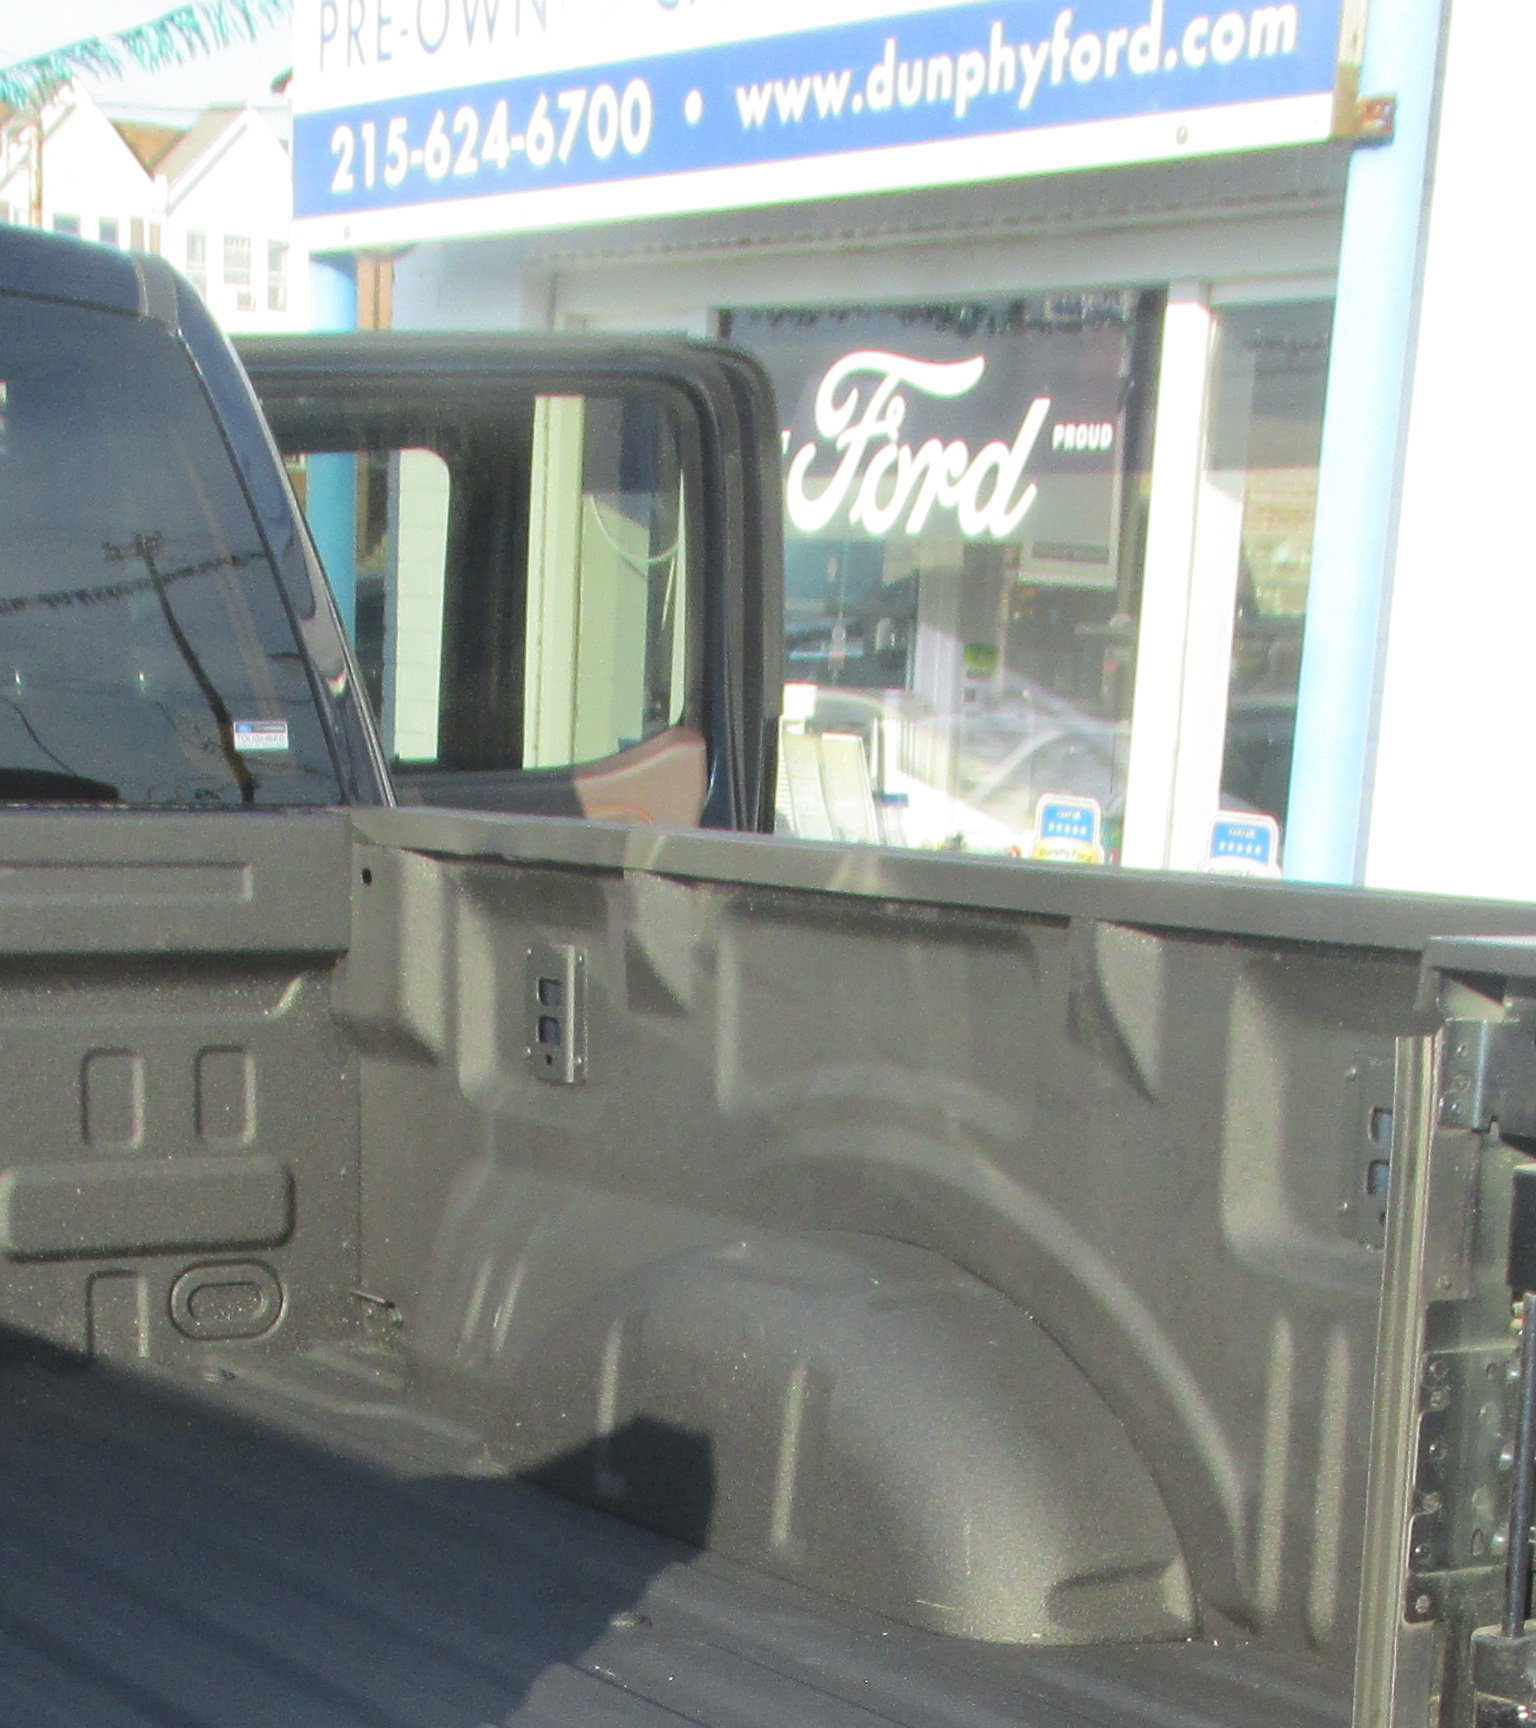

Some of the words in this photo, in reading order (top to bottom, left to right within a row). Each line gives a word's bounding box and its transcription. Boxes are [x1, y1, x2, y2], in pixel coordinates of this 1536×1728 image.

[330, 77, 653, 194] 215-624-6700
[735, 0, 1299, 129] www.dunphyford.com
[787, 349, 1051, 539] Ford
[1051, 422, 1113, 451] PROUD
